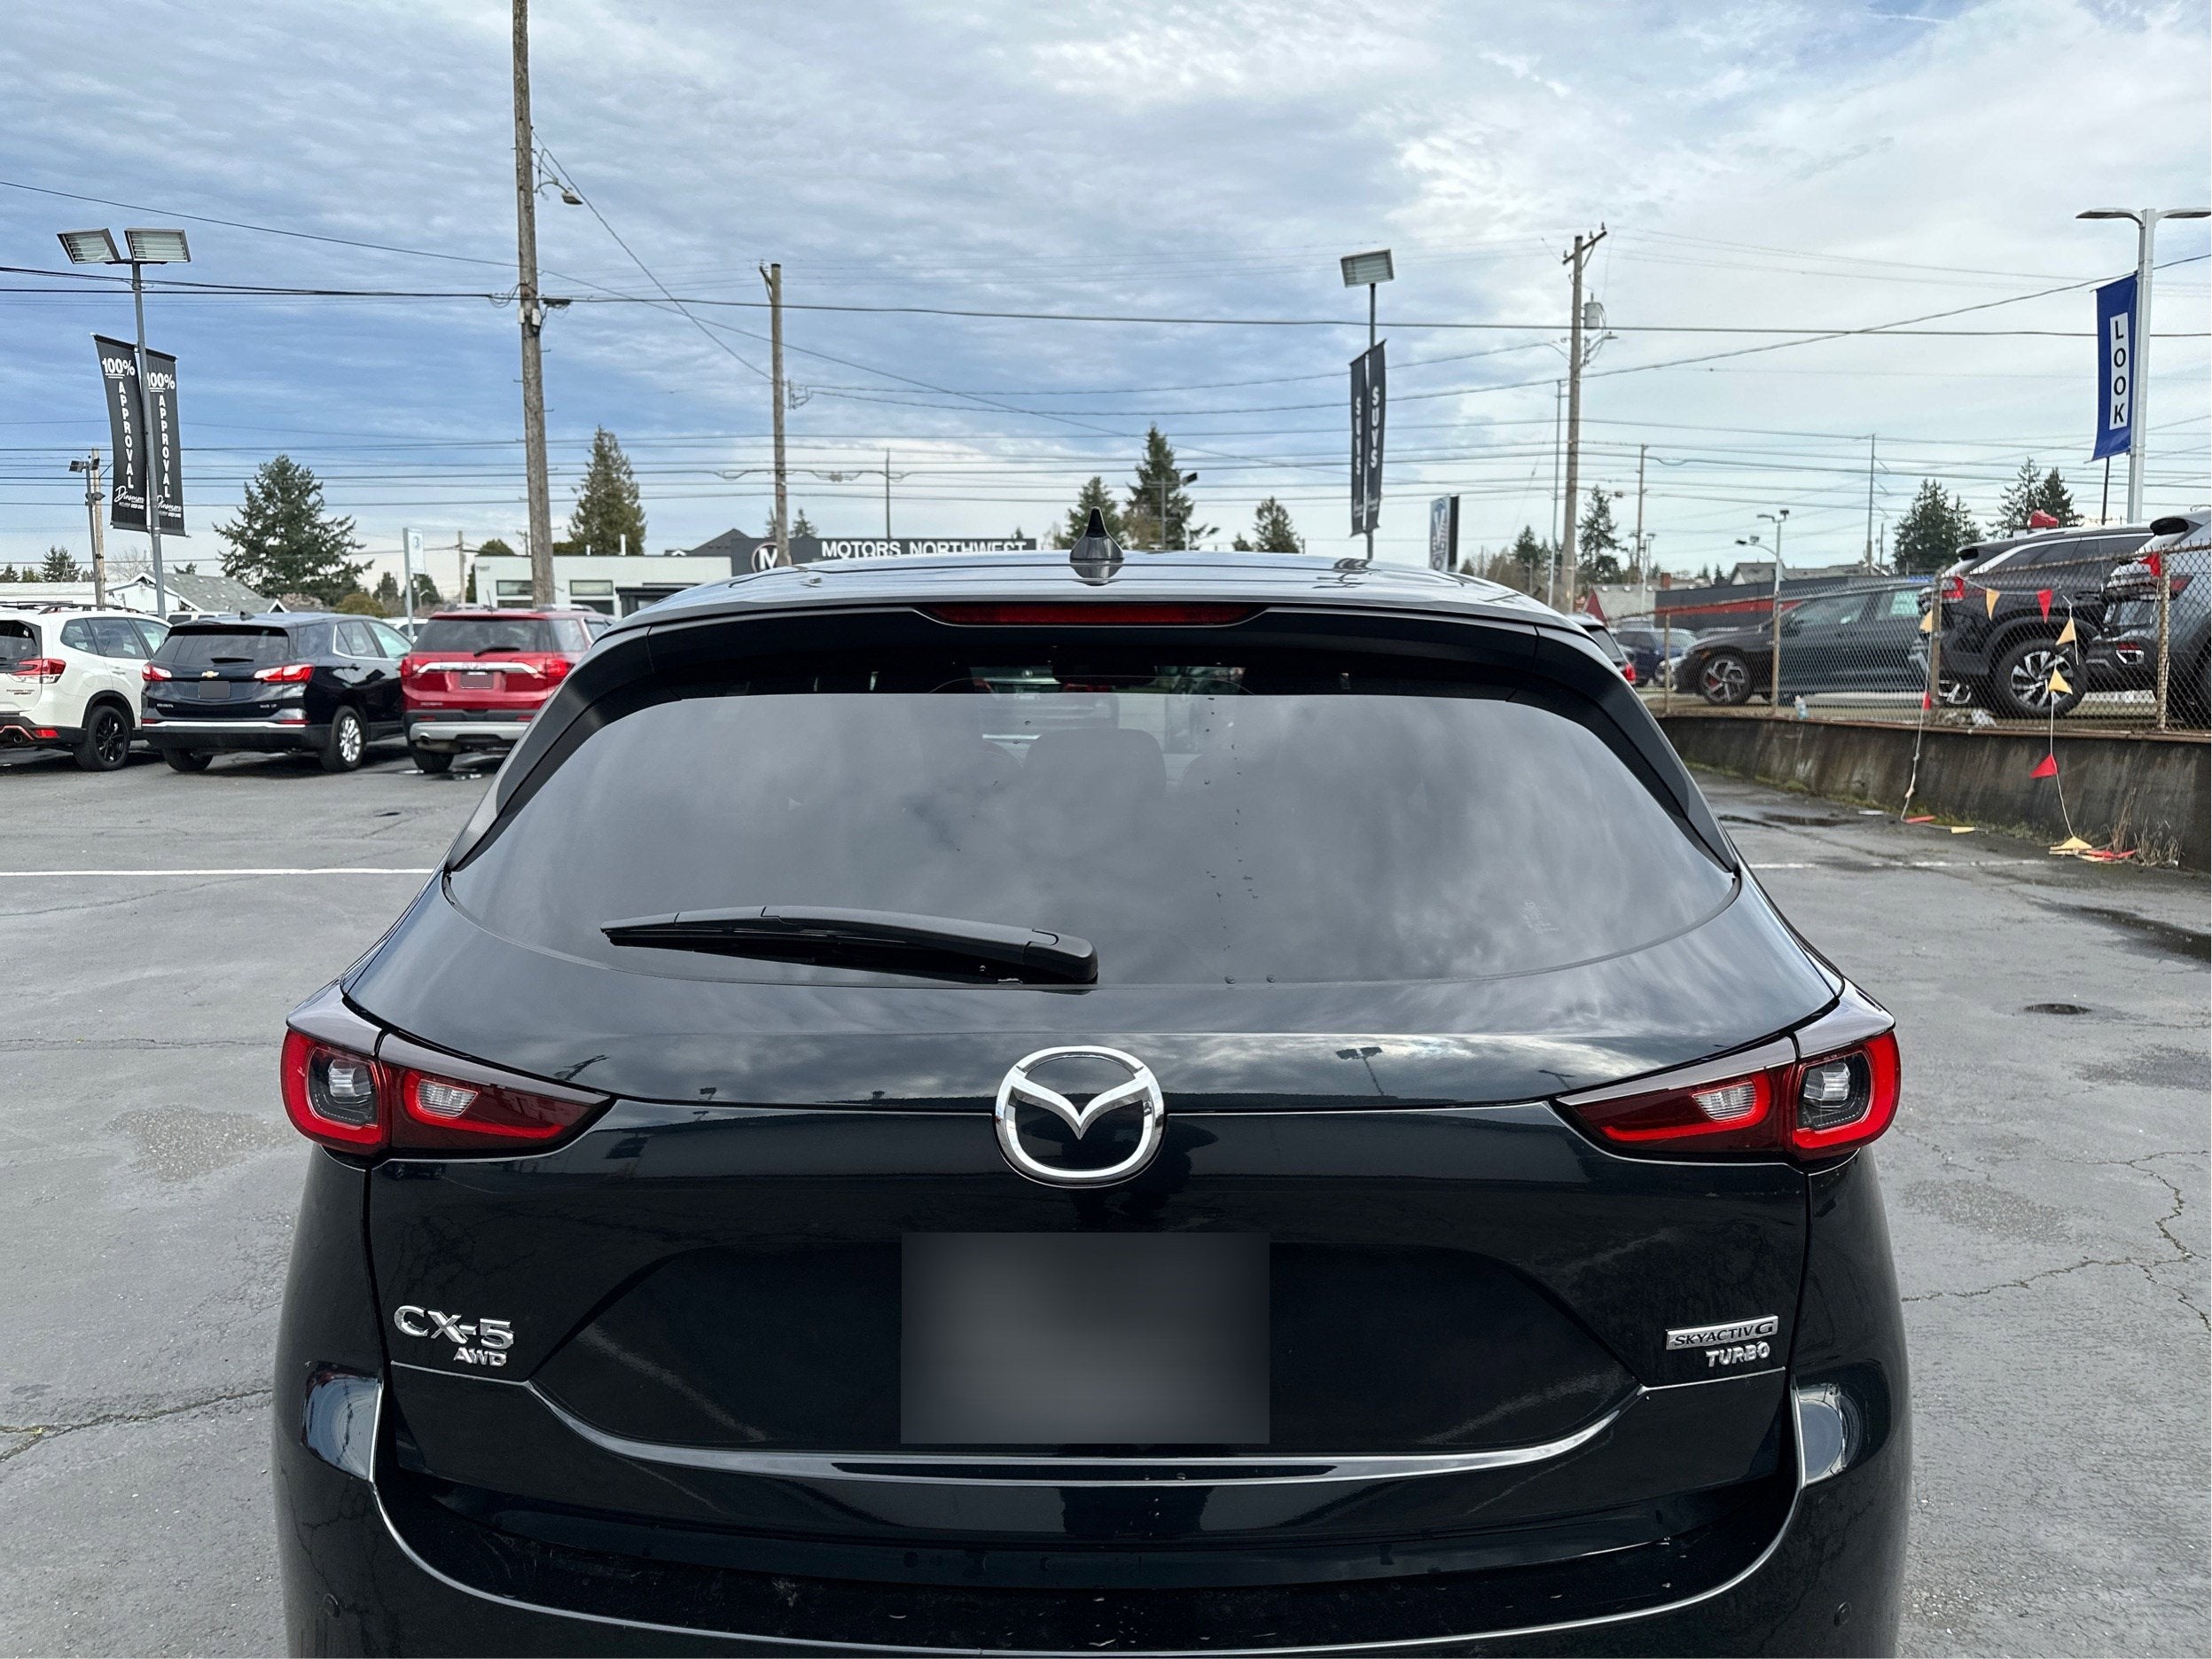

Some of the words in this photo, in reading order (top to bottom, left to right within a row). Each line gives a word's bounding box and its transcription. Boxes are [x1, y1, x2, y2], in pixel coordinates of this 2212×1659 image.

[102, 357, 136, 376] 100%
[146, 372, 176, 390] 100%
[2113, 320, 2127, 425] LOOK
[119, 381, 134, 489] APPROVAL
[1371, 386, 1380, 469] SUVS
[159, 395, 170, 498] APPROVAL
[821, 540, 902, 558] MOTORS
[909, 540, 1027, 555] NORTHWEST
[394, 1304, 514, 1350] CX-5
[453, 1346, 508, 1367] AWD
[1705, 1340, 1770, 1367] TURBO
